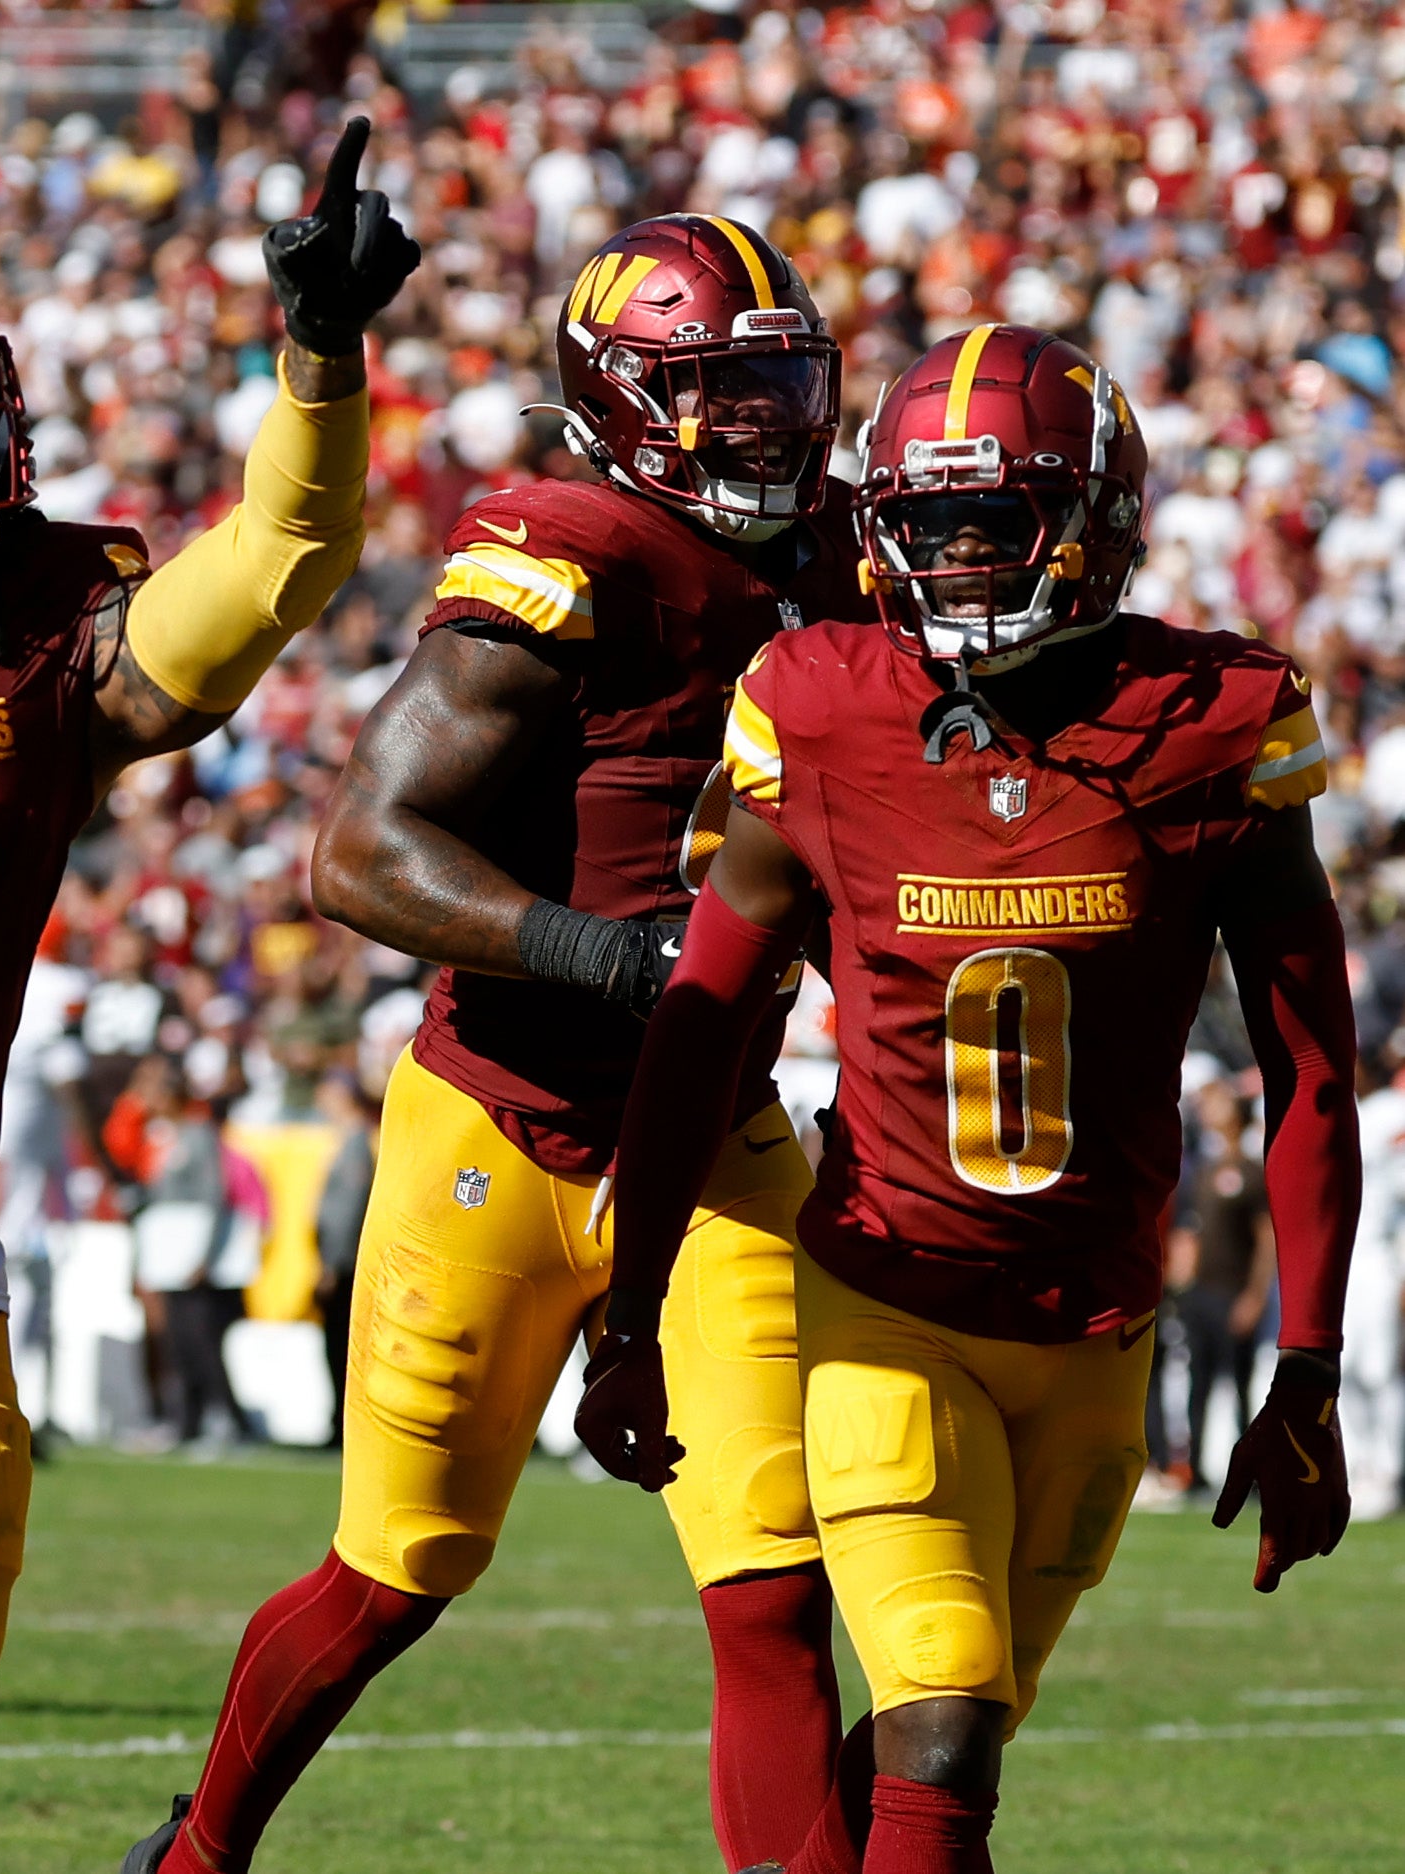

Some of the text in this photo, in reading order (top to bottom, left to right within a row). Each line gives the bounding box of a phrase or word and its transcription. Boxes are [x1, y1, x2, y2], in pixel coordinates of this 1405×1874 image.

[670, 333, 713, 343] OAKLEY
[898, 883, 1128, 925] COMMANDERS
[945, 947, 1074, 1195] 0
